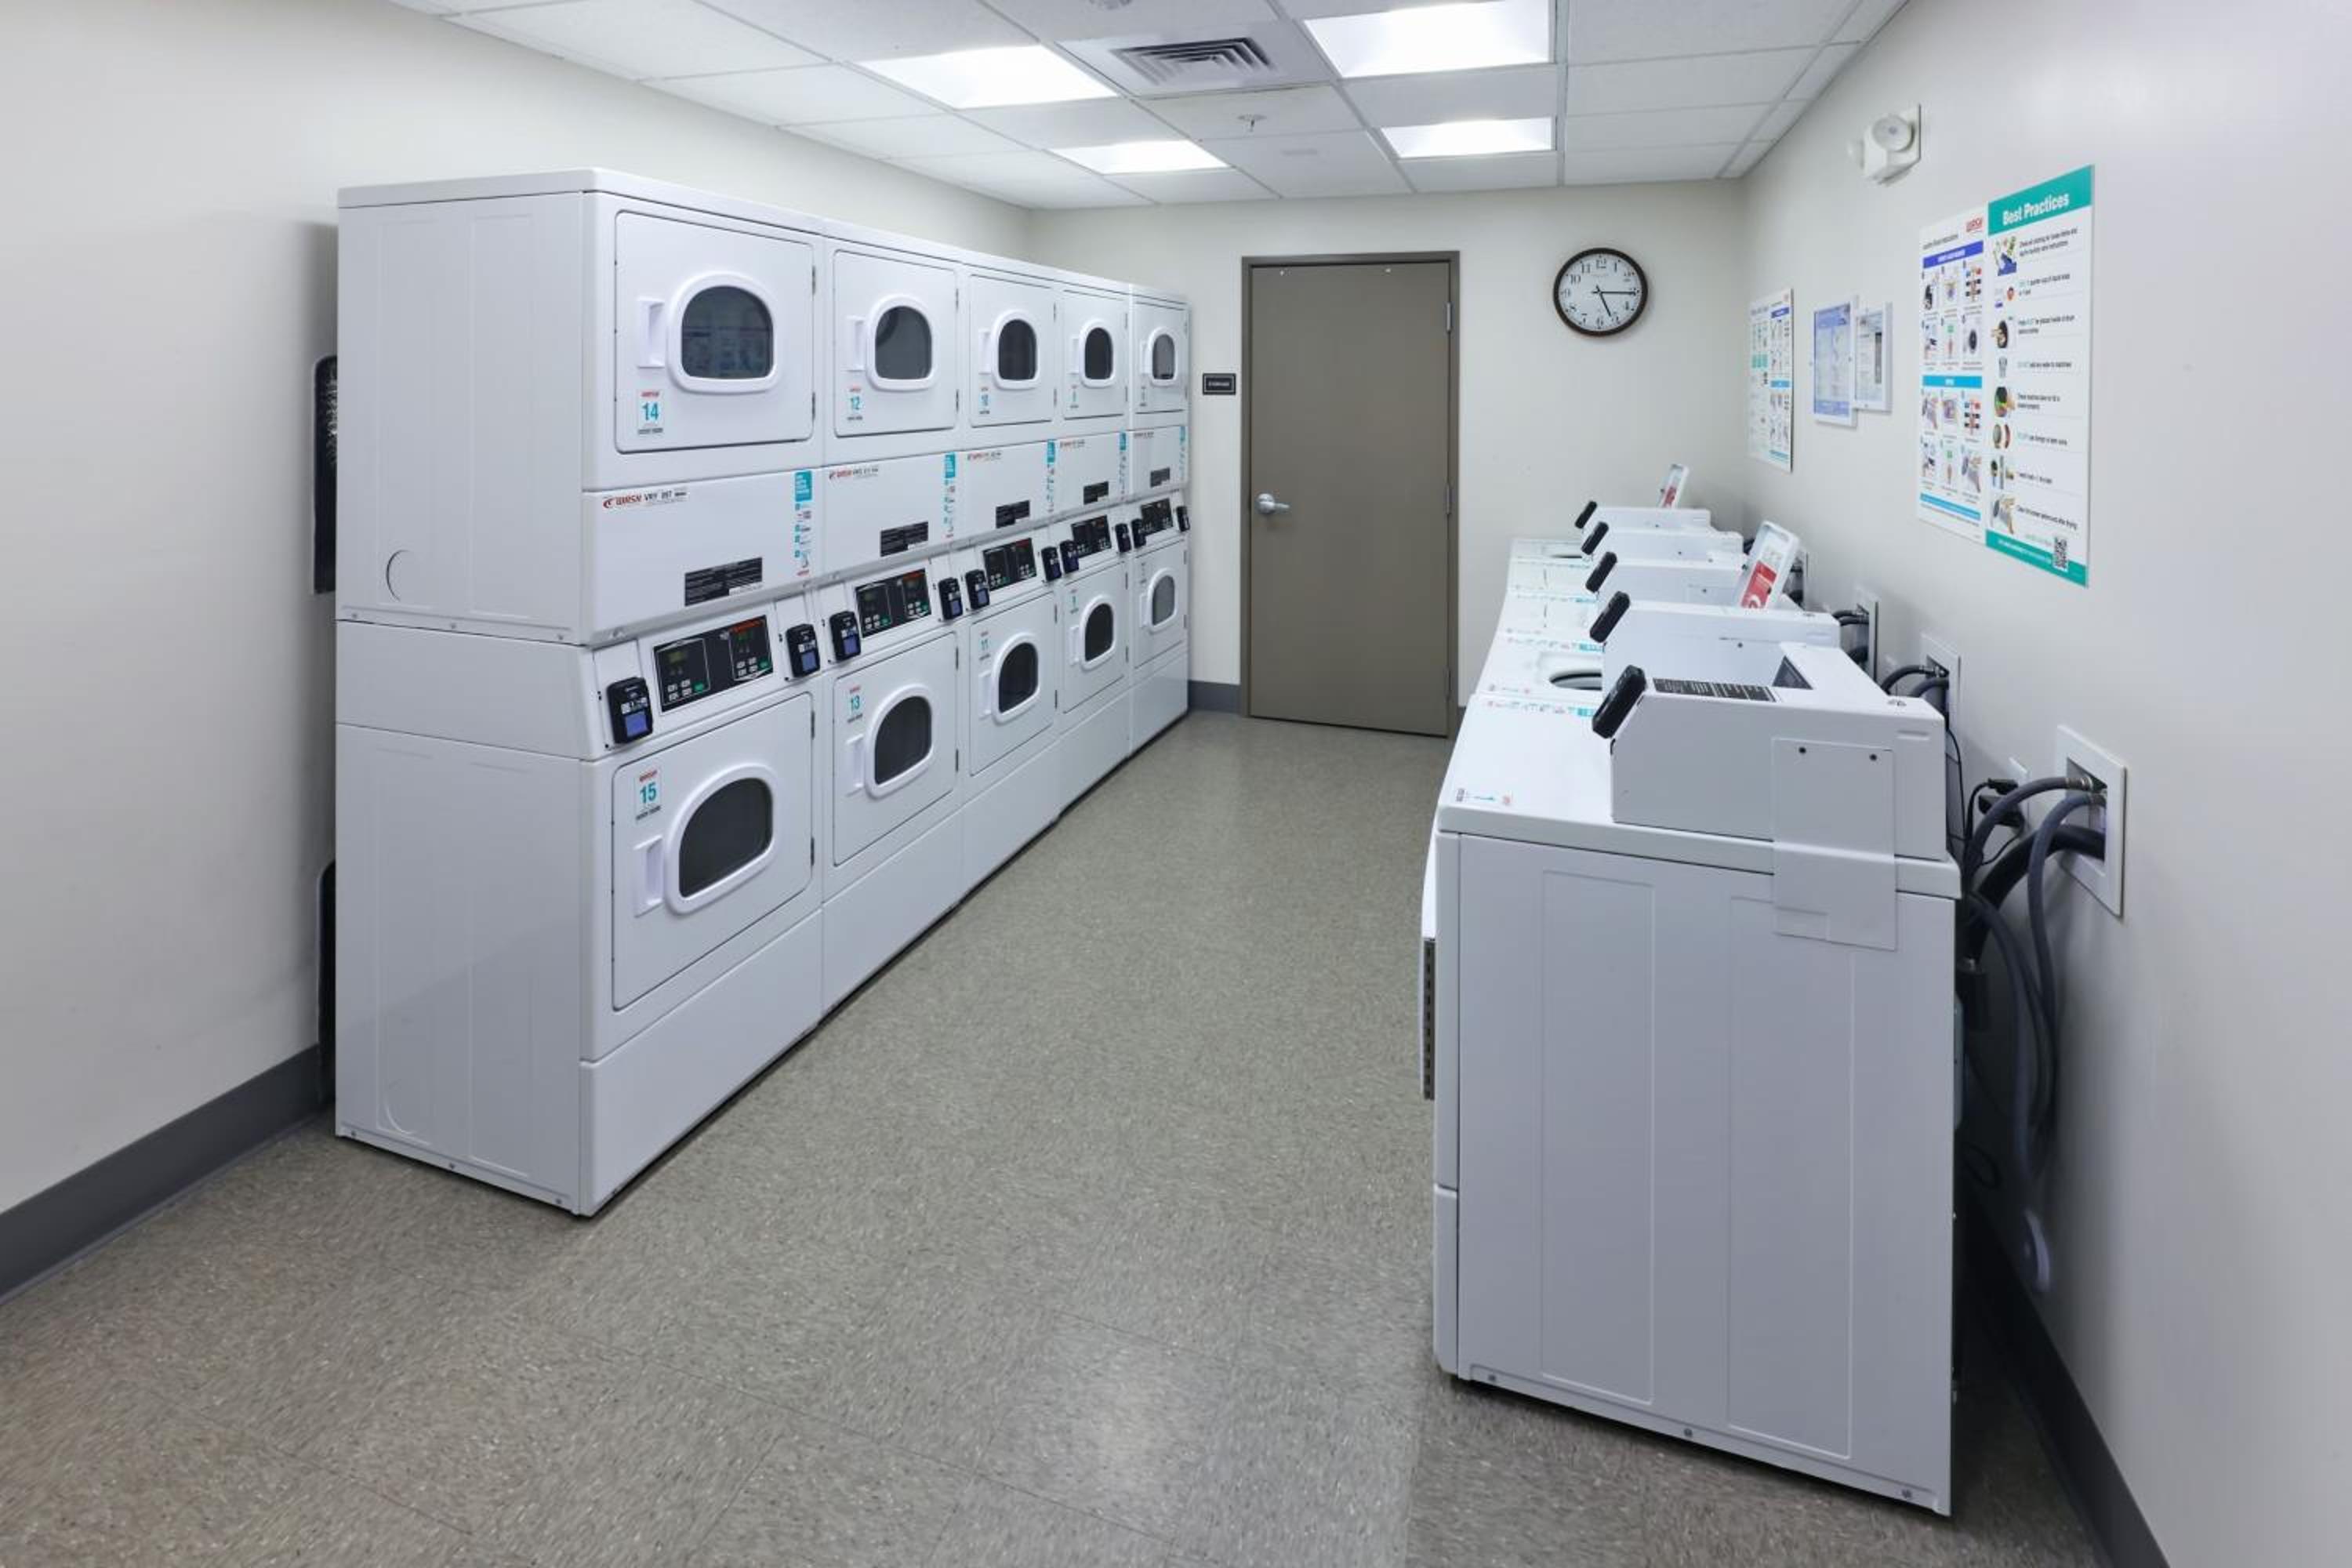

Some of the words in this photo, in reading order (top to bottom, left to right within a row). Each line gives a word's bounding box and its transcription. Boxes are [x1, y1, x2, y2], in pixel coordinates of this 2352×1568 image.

[2002, 205, 2023, 226] Best
[2024, 194, 2070, 219] Practices
[642, 402, 659, 421] 14
[851, 695, 861, 712] 13
[639, 782, 657, 804] 15
